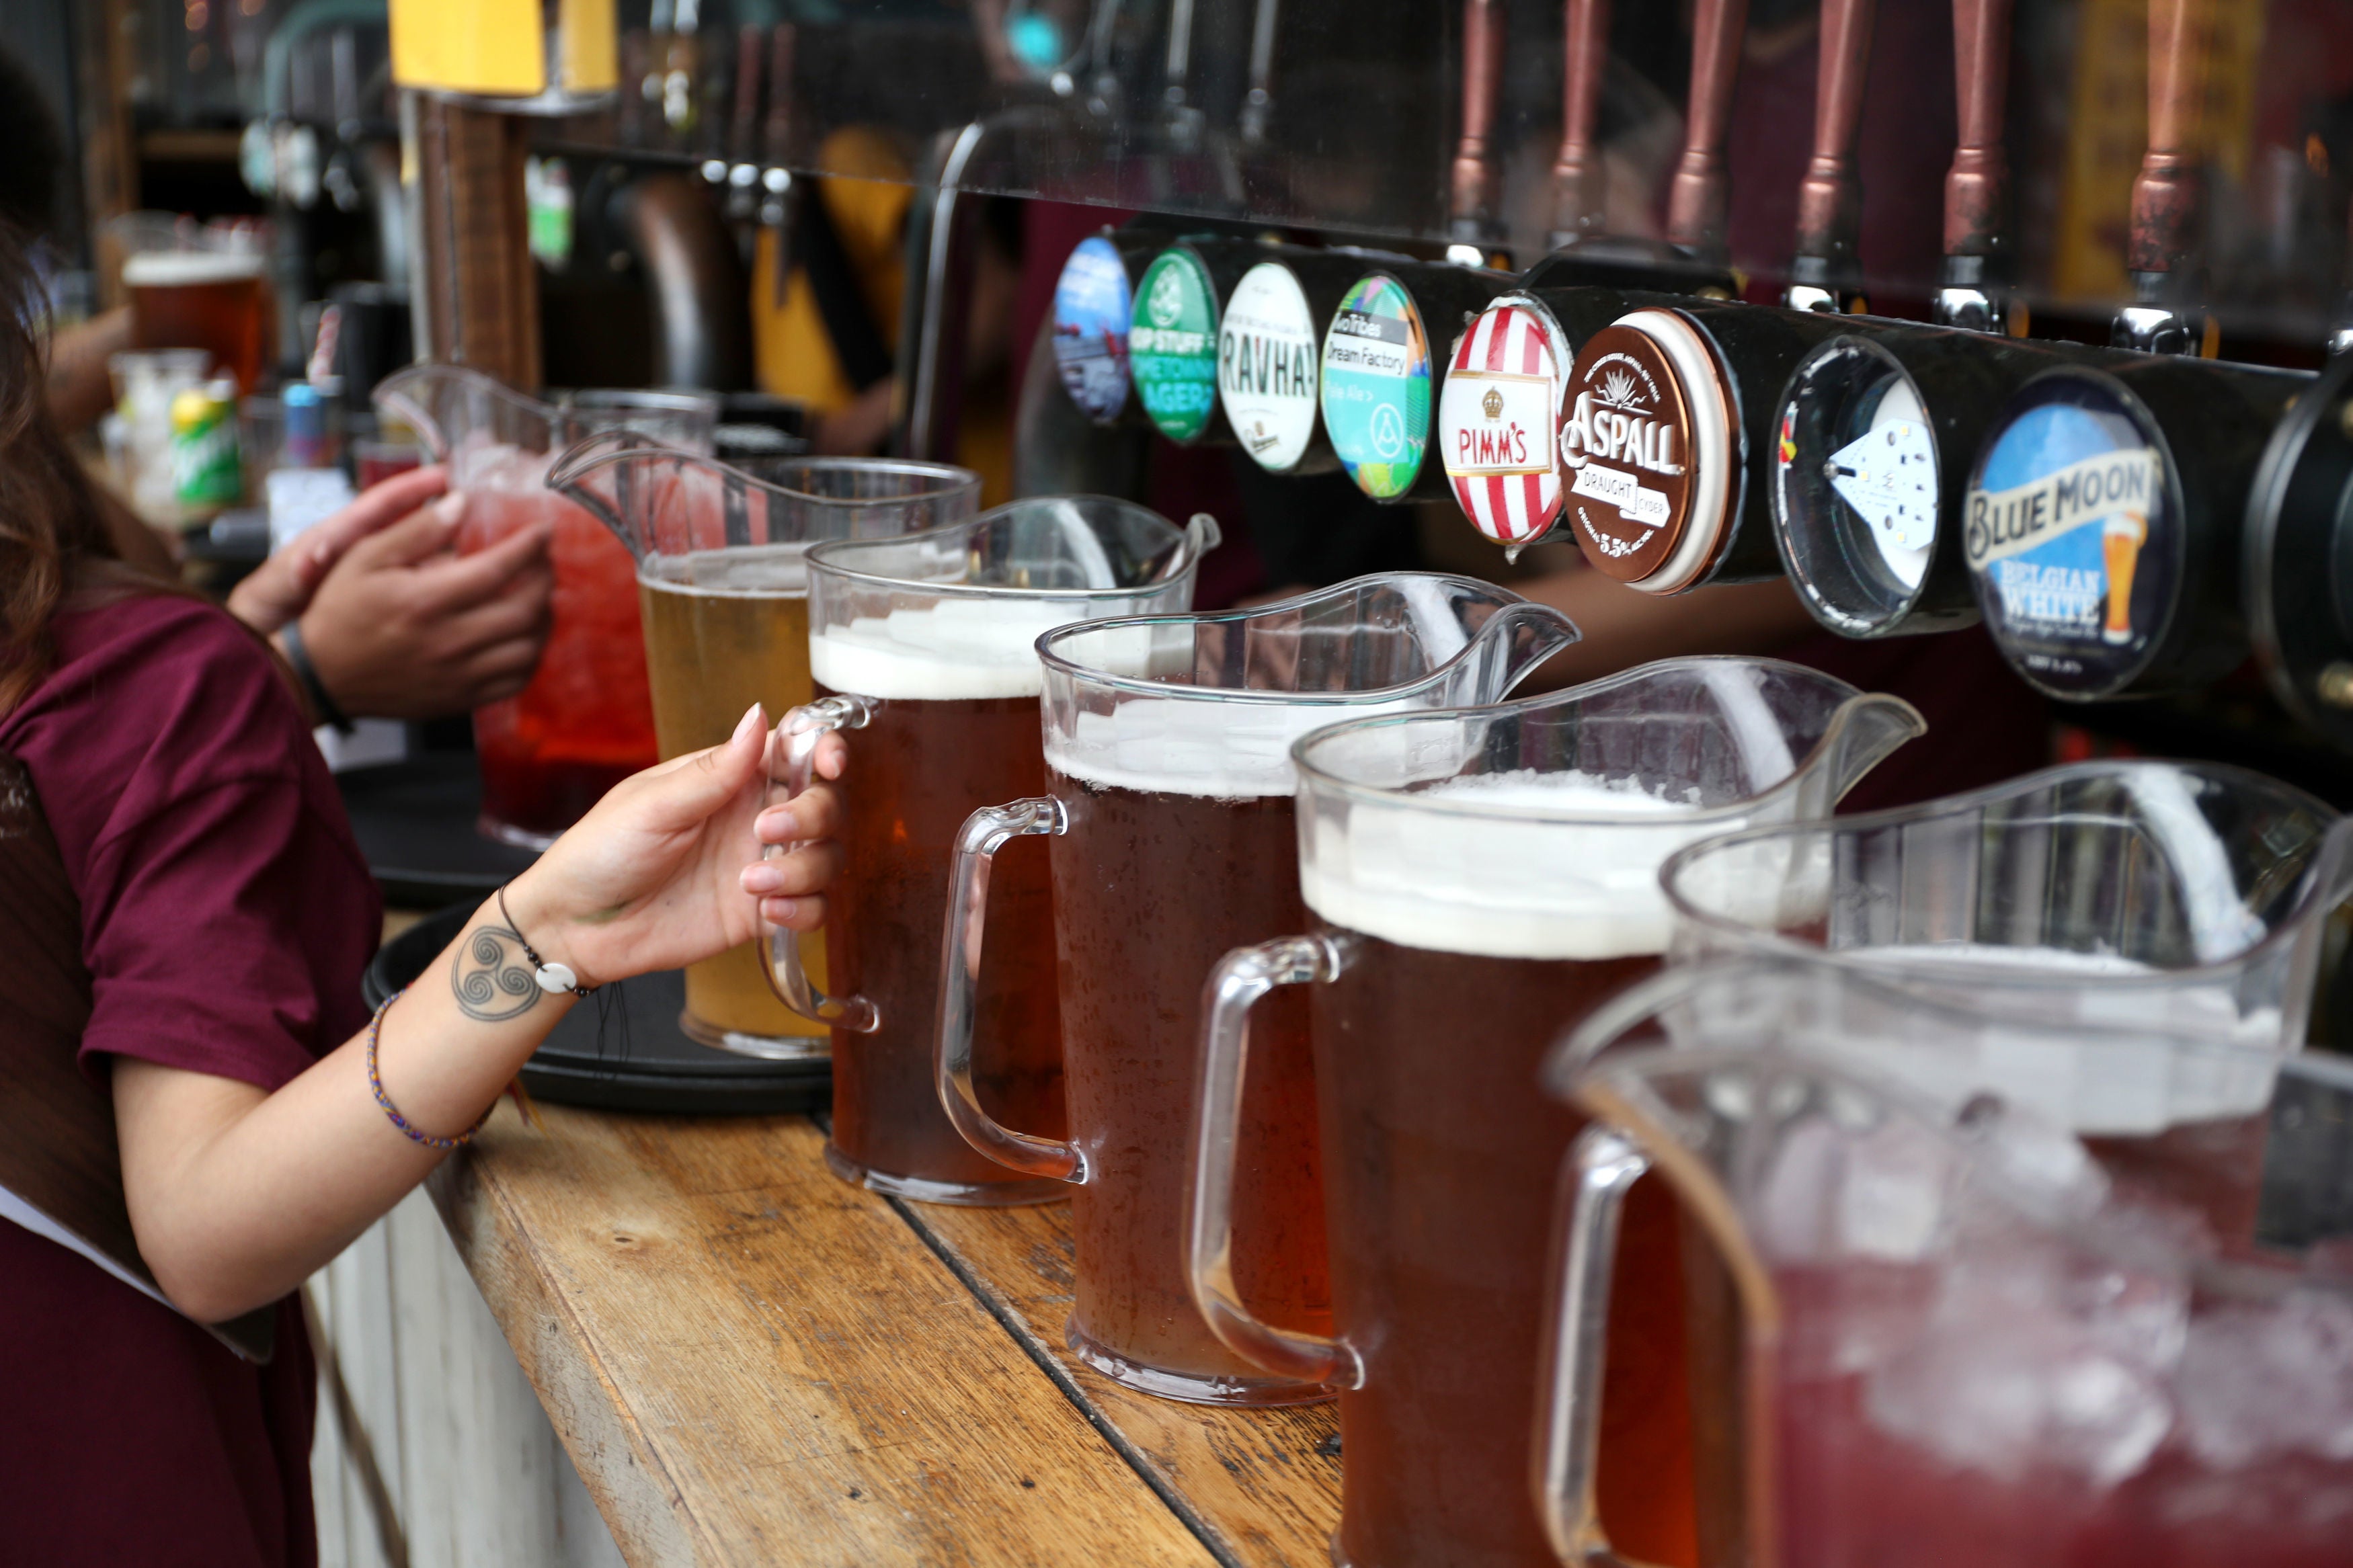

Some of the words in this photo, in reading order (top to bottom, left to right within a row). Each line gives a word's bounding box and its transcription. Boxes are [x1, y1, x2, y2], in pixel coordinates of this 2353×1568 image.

[1361, 346, 1406, 376] Factory
[1459, 421, 1527, 464] PIMM'S
[1560, 390, 1682, 476] ASPALL
[1584, 472, 1632, 499] DRAUGHT
[1638, 498, 1664, 515] CYDER
[1968, 490, 2048, 561] BLUE
[2053, 461, 2145, 523] MOON
[2001, 559, 2101, 594] BELGIAN
[2002, 585, 2100, 625] WHITE
